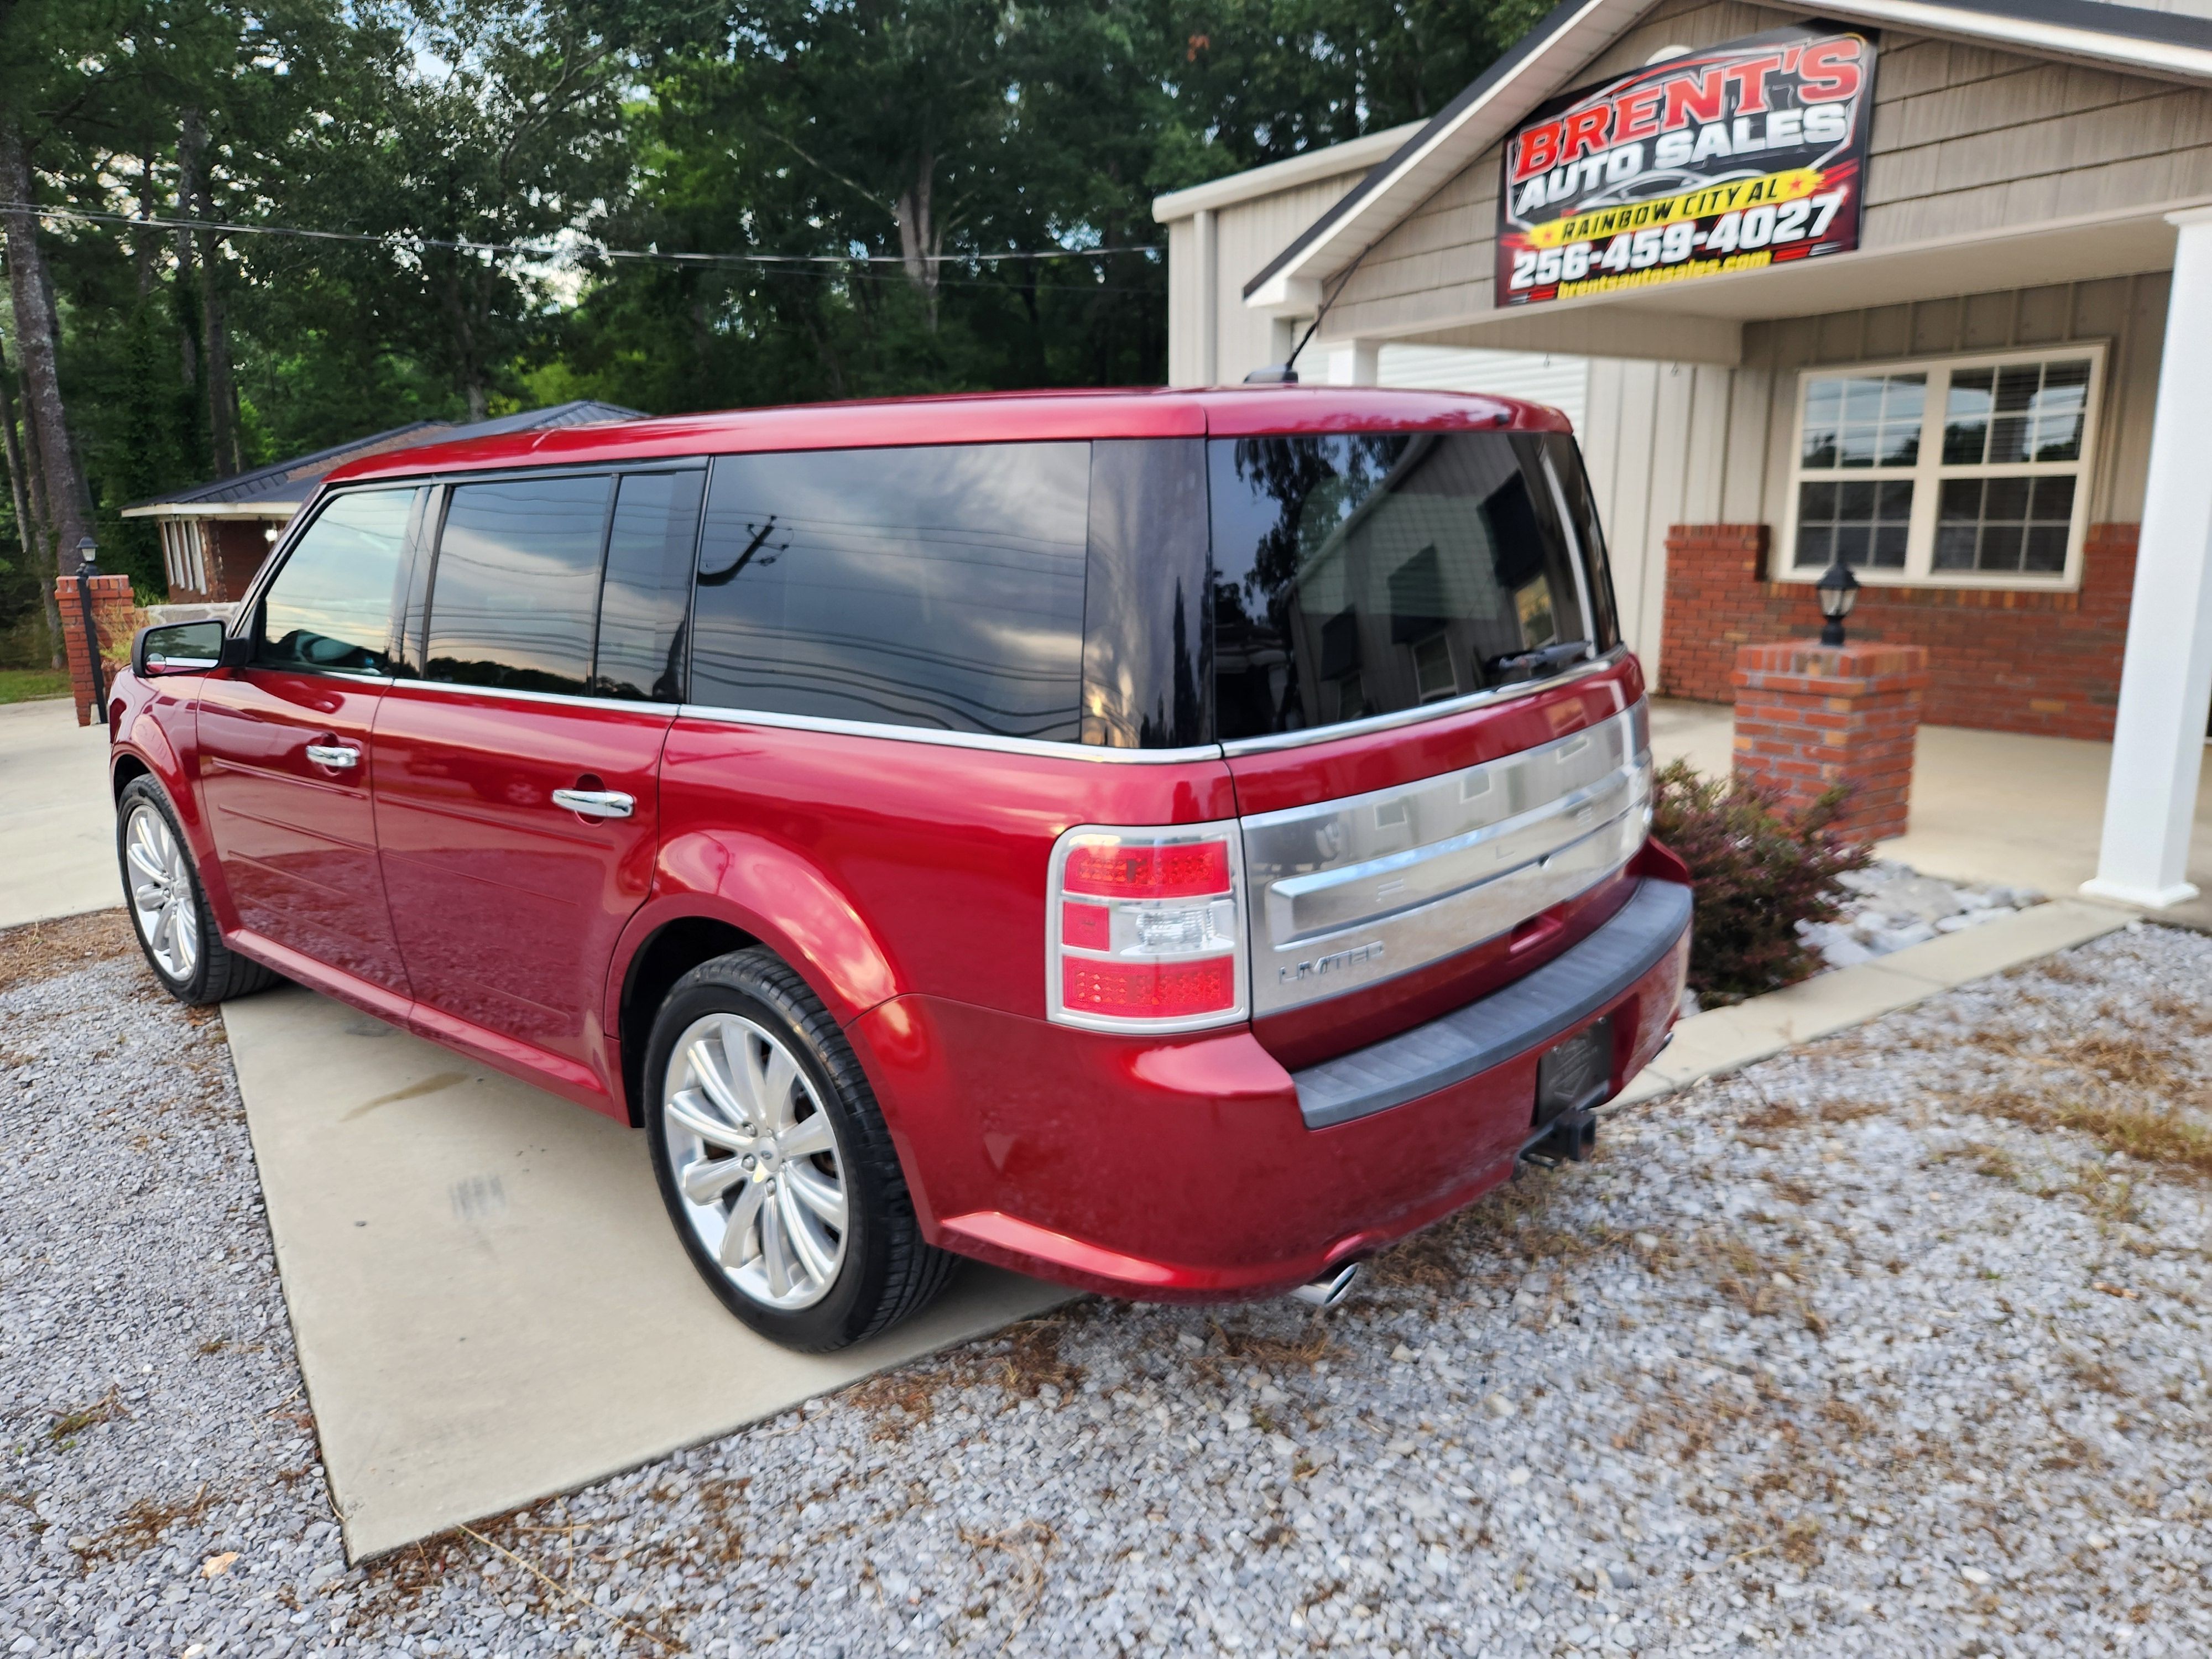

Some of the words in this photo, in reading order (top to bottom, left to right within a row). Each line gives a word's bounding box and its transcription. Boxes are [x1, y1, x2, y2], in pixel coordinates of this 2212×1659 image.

[1513, 39, 1864, 182] BRENT'S
[1515, 142, 1645, 216] AUTO
[1654, 103, 1848, 170] SALES
[1510, 189, 1848, 290] 256-459-4027
[1561, 197, 1676, 241] RAINBOW
[1683, 183, 1742, 216] CITY
[1747, 176, 1778, 202] AL
[1557, 251, 1772, 300] brentsautosales.com
[1279, 940, 1384, 984] LIMITED
